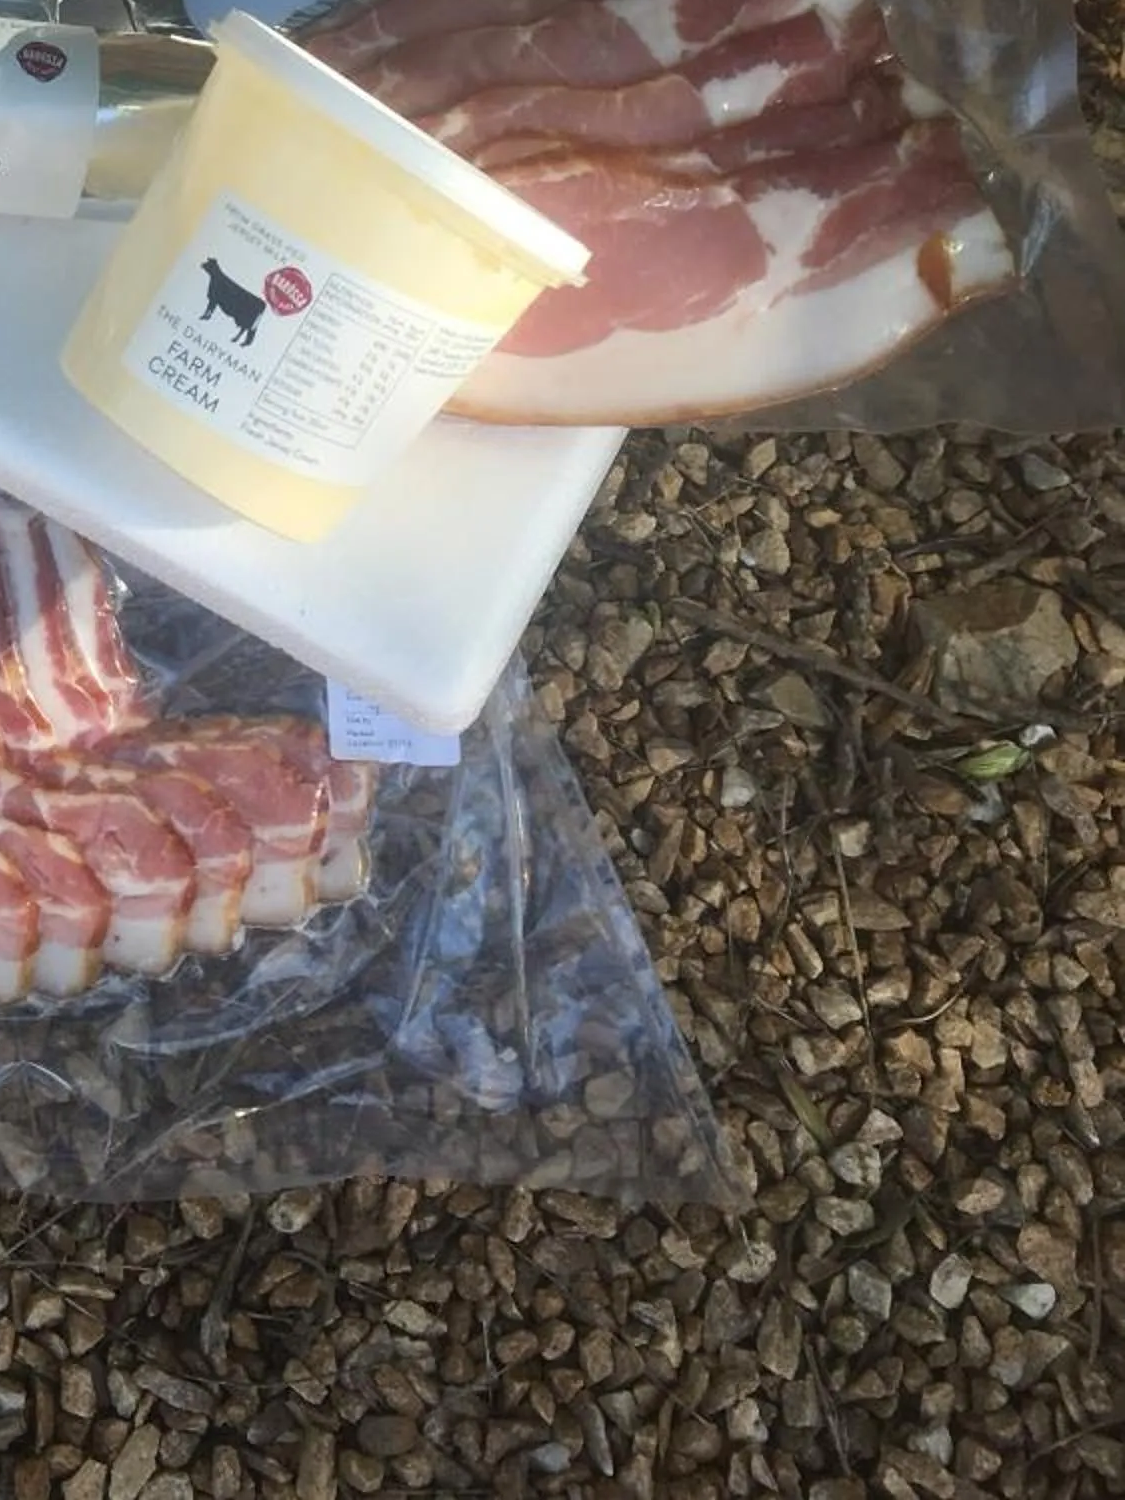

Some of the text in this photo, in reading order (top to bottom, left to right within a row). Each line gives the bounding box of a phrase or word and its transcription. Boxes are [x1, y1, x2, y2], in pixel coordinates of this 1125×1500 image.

[157, 304, 181, 331] THE
[182, 324, 263, 384] DAIRYMAN
[166, 339, 223, 388] FARM
[148, 355, 220, 414] CREAM
